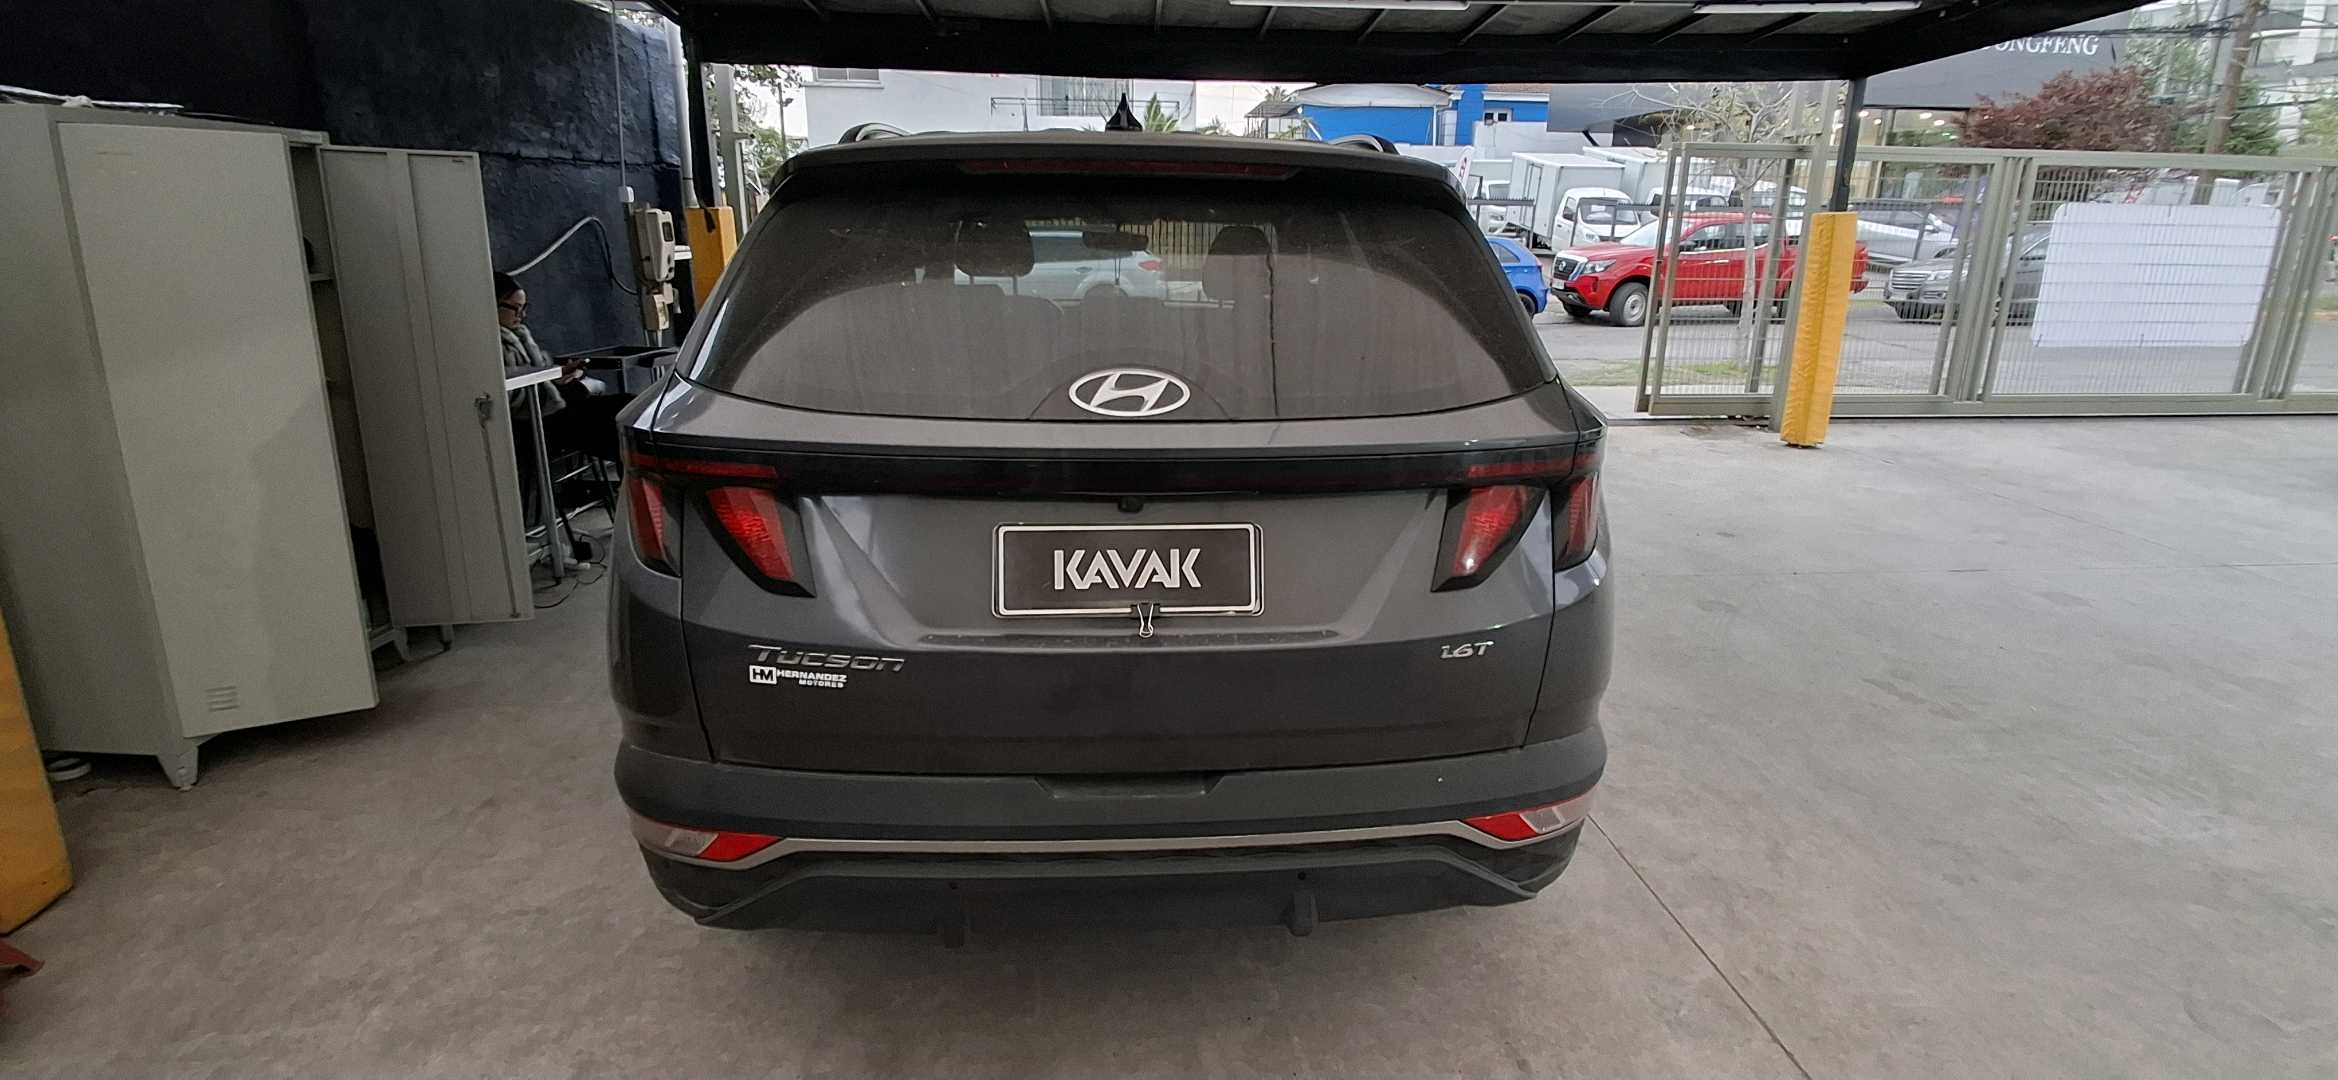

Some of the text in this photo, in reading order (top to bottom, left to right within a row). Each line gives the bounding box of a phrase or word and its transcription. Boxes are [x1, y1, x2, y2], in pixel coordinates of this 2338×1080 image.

[1984, 34, 2099, 56] ONGFENG
[1054, 548, 1202, 590] KAVAK
[752, 667, 847, 683] HM HERNANDEZ
[798, 679, 844, 689] MOTORES
